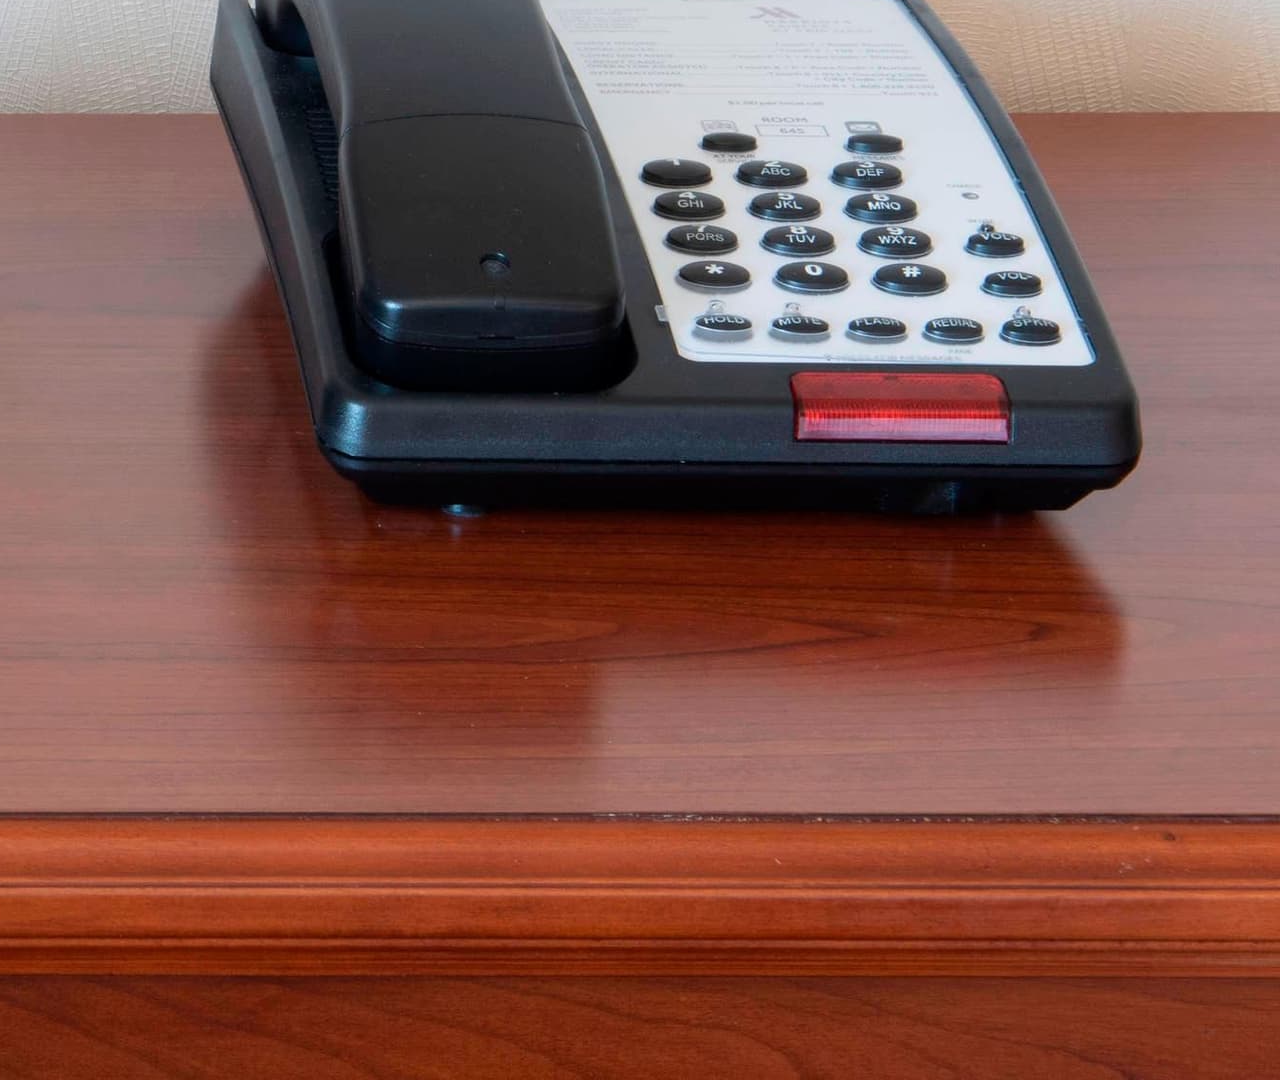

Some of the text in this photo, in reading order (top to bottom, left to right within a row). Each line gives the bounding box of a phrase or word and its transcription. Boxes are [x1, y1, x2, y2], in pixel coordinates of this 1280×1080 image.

[760, 167, 791, 176] ABC
[856, 168, 885, 177] DEF
[677, 200, 704, 208] GHI
[774, 201, 803, 210] JKL
[867, 201, 901, 211] MNO
[685, 232, 725, 242] PQRS
[785, 234, 817, 244] TUV
[878, 235, 918, 246] WXYZ
[804, 264, 823, 276] 0
[901, 265, 921, 278] #
[703, 316, 746, 325] HOLD
[778, 316, 821, 326] MUTE
[854, 318, 901, 327] FLASH
[930, 319, 977, 329] REDIAL
